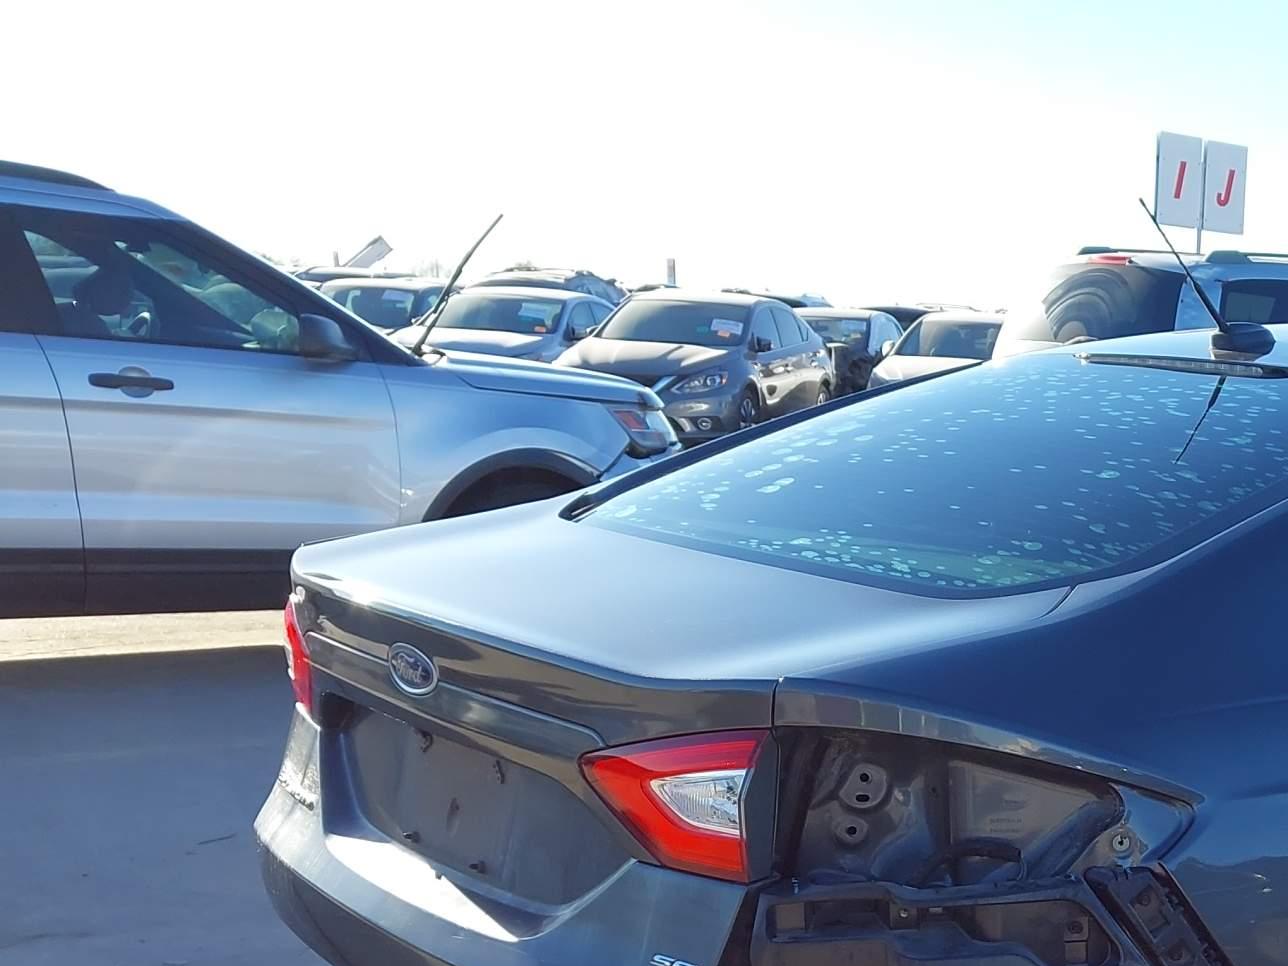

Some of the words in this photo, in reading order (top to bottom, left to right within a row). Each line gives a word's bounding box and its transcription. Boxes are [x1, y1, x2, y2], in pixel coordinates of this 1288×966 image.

[1174, 160, 1187, 199] I
[1216, 168, 1236, 207] J
[391, 652, 427, 683] Ford
